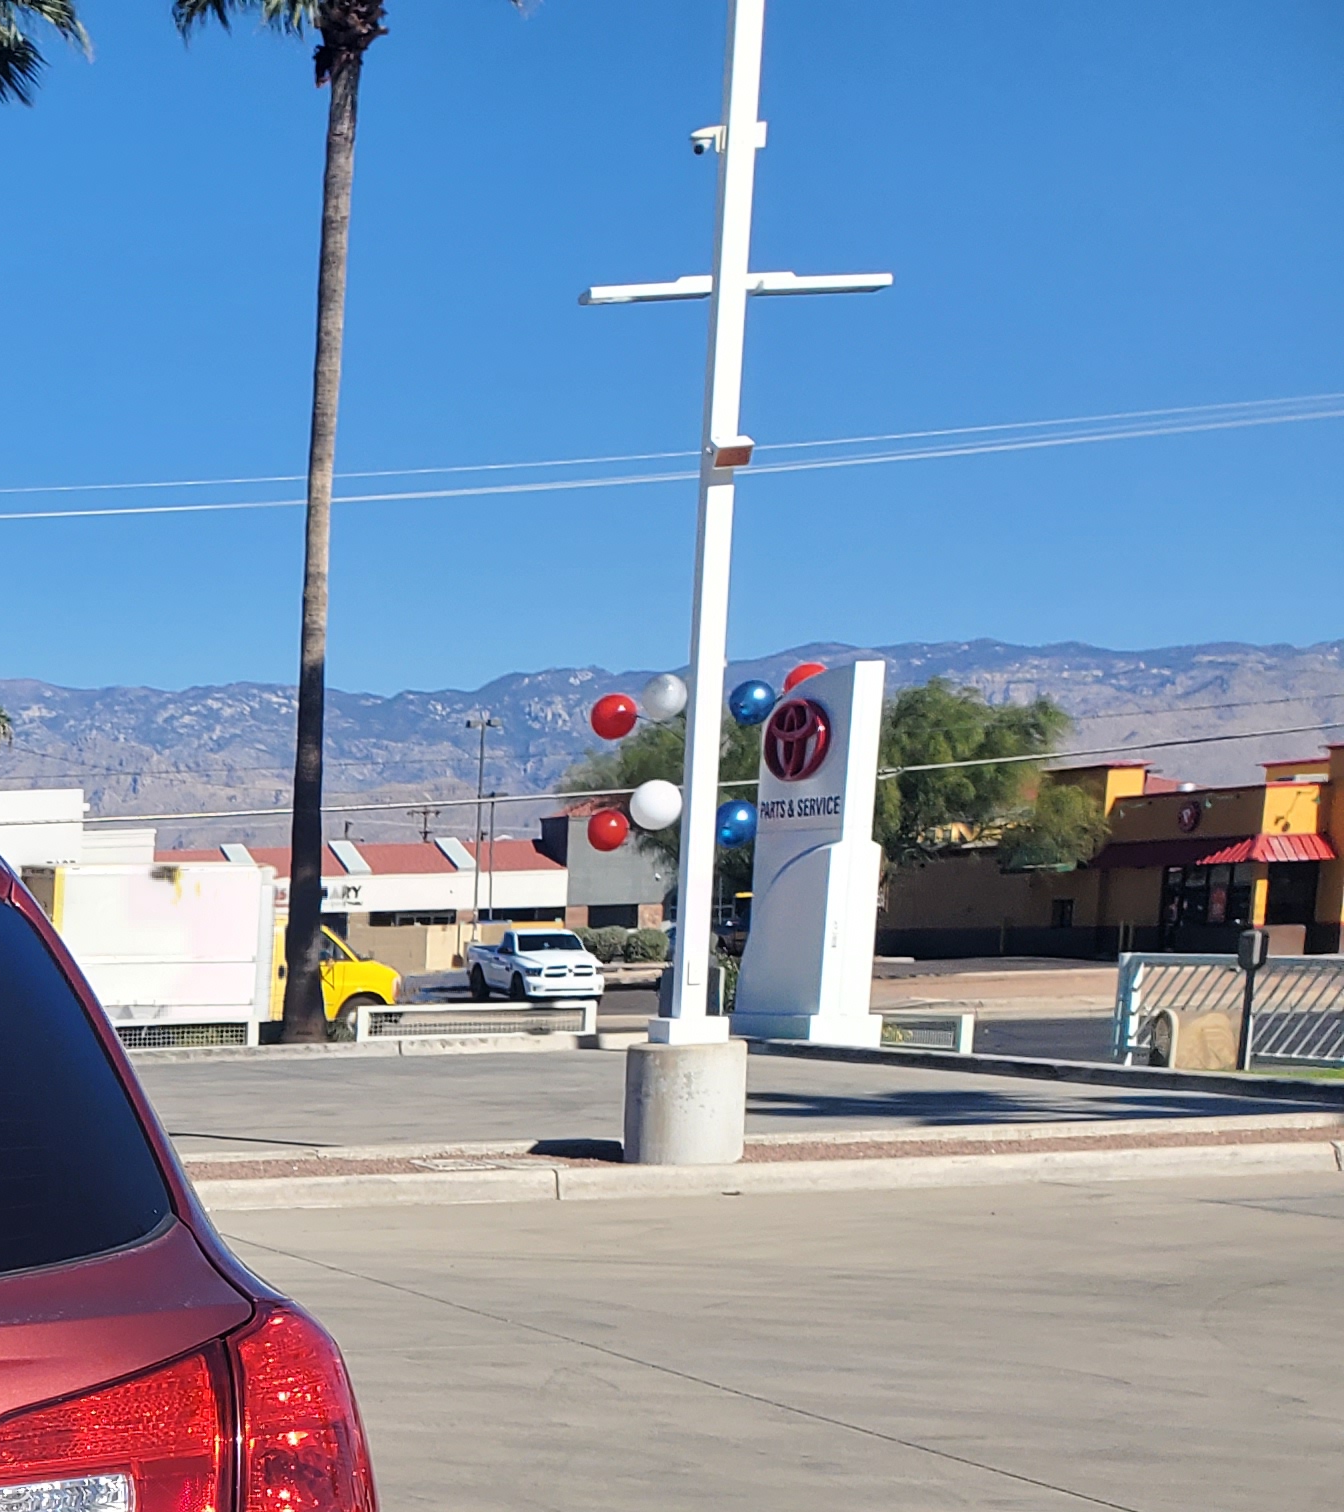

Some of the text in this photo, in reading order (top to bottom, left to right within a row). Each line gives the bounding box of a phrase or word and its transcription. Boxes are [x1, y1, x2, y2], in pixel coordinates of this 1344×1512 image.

[760, 795, 841, 819] PARTS & SERVICE
